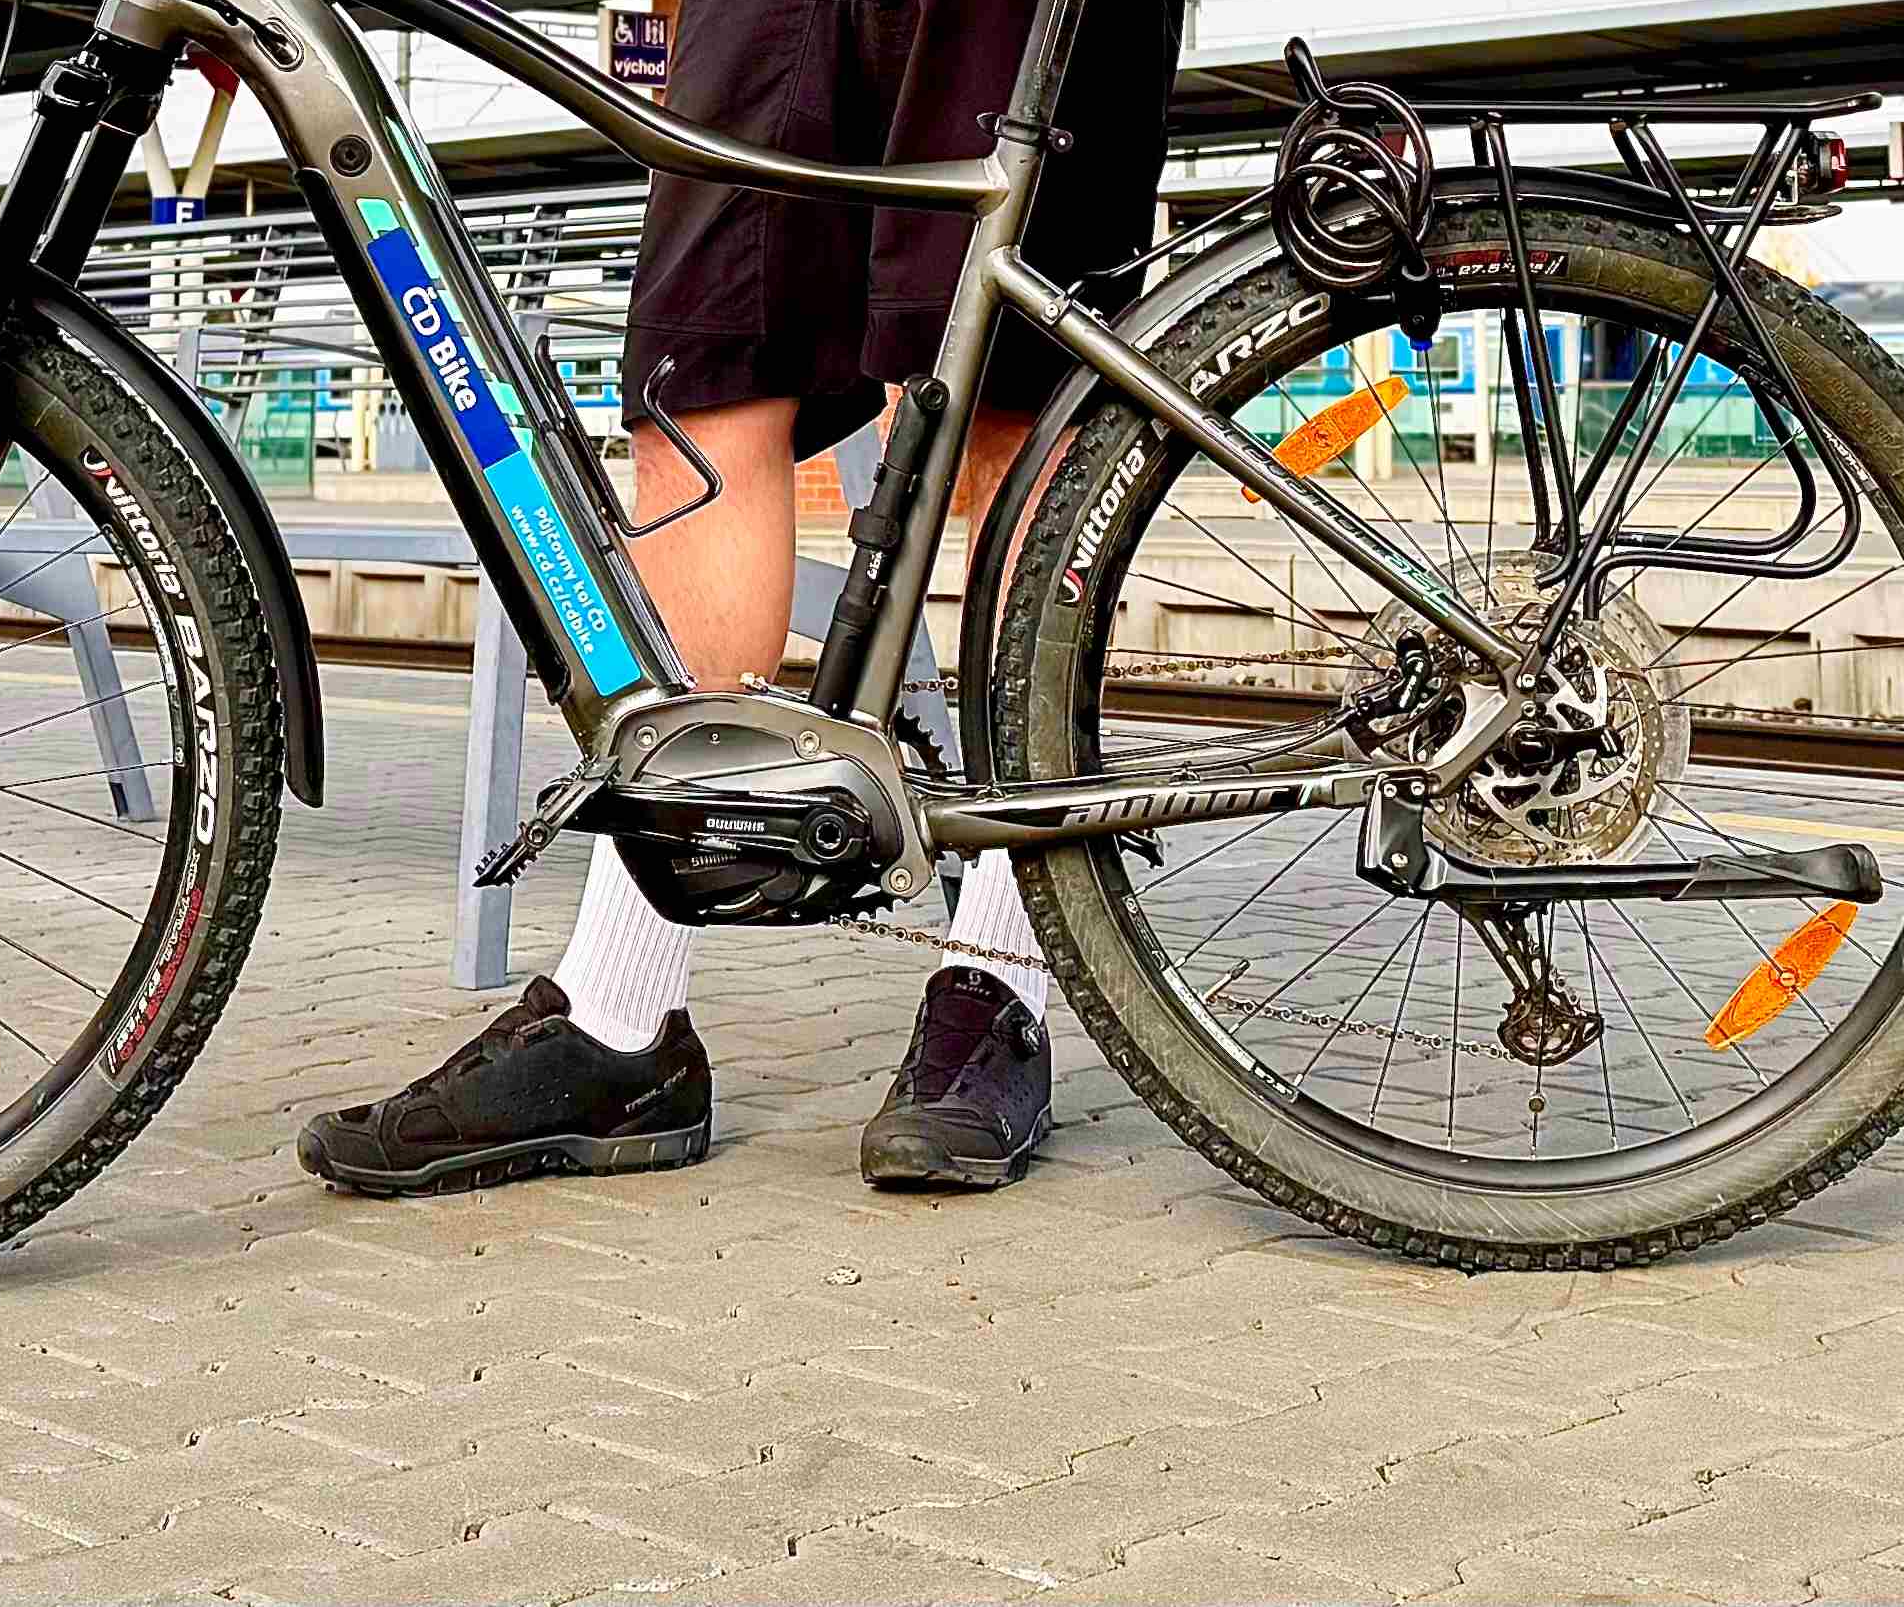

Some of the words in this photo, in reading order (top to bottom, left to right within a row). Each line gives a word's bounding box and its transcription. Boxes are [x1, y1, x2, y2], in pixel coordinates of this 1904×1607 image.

[614, 57, 665, 78] východ
[402, 286, 441, 336] ČD
[428, 335, 477, 412] Bike
[534, 506, 577, 581] Půjčovny
[587, 607, 606, 633] ČD
[1072, 447, 1146, 569] vittoria
[511, 504, 594, 654] www.cd.cz/cdbike
[102, 480, 181, 594] vittoria
[174, 614, 218, 845] BARZO
